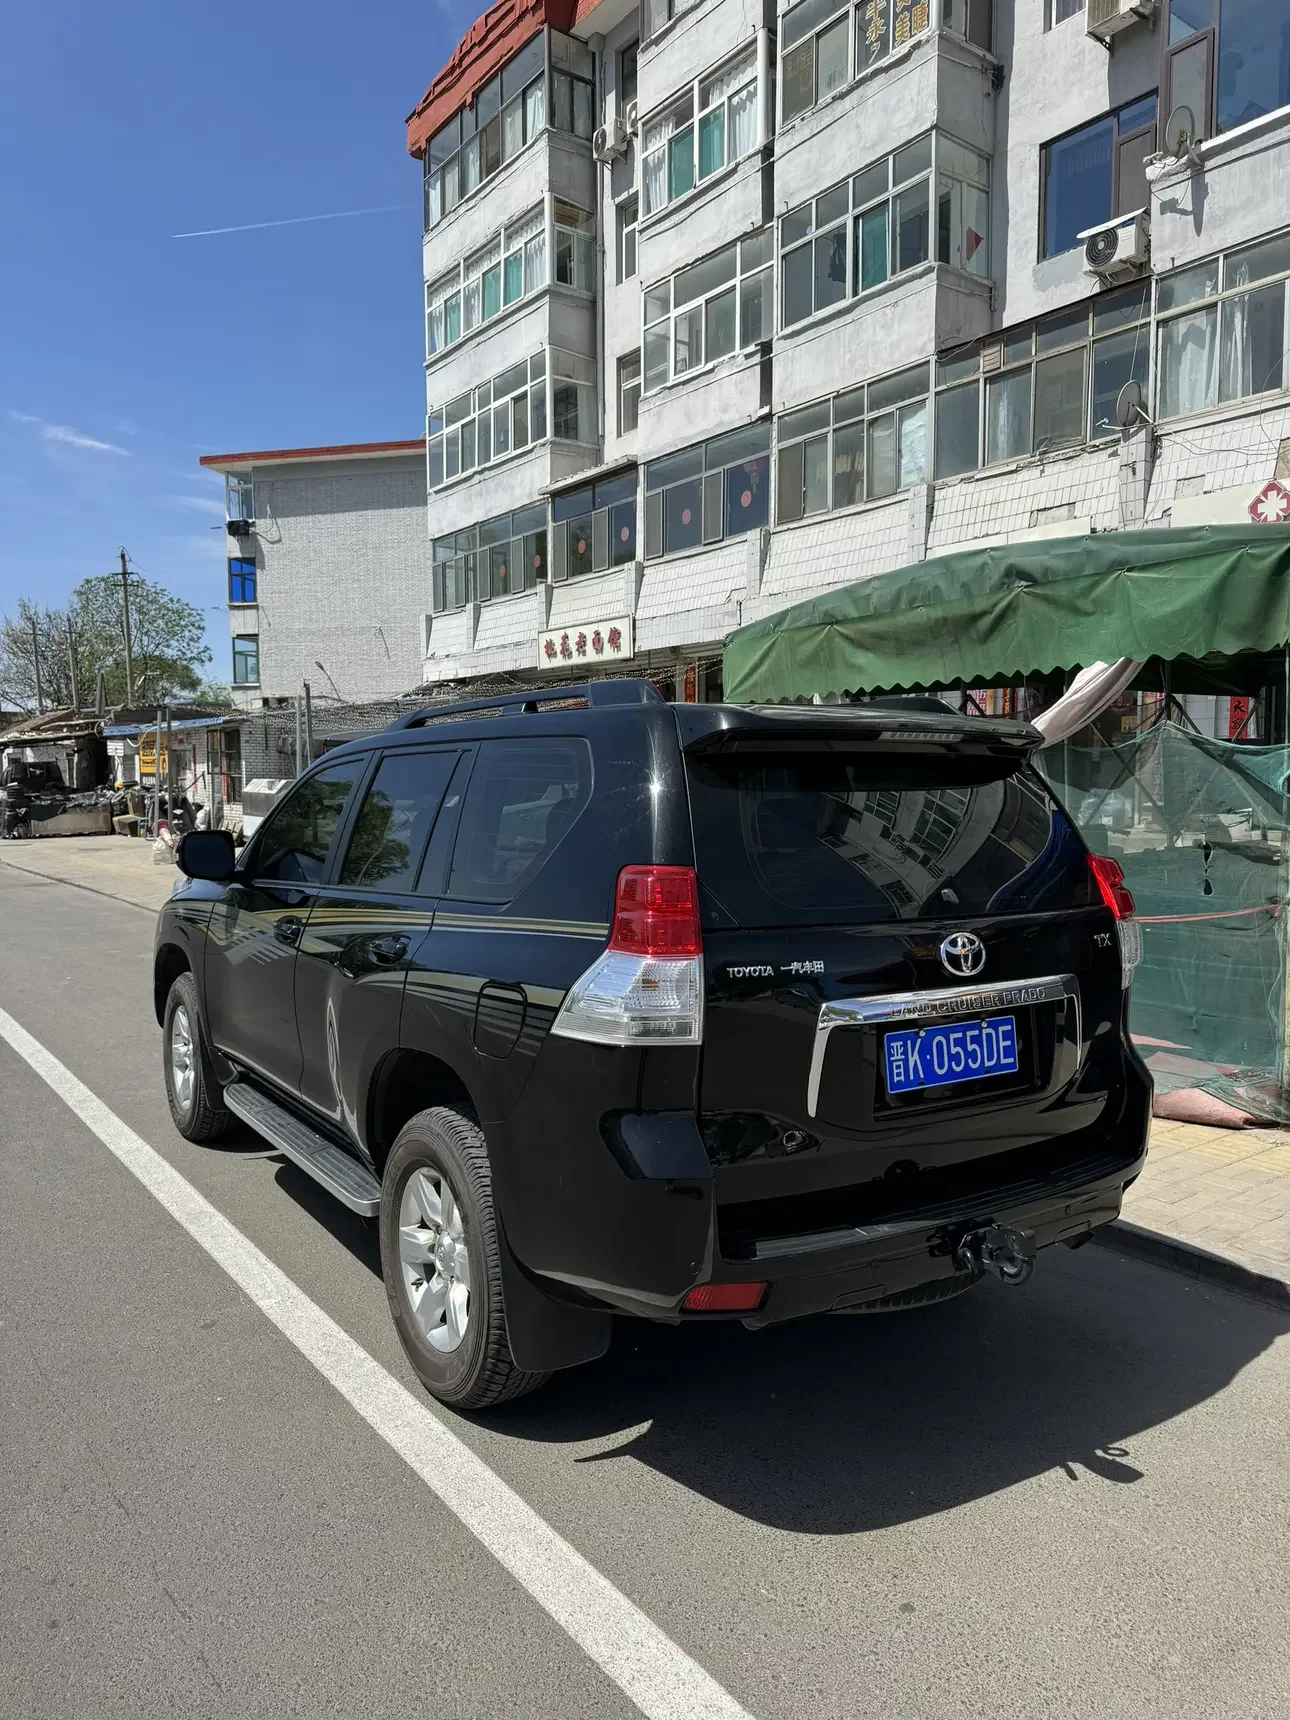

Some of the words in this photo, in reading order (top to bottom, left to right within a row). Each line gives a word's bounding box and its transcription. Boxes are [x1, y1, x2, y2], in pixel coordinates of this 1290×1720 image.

[1093, 932, 1112, 948] TX
[726, 965, 775, 979] TOYOTA
[890, 1003, 936, 1018] LAND
[937, 994, 1001, 1013] CRUISER
[1003, 986, 1046, 1005] PRADO
